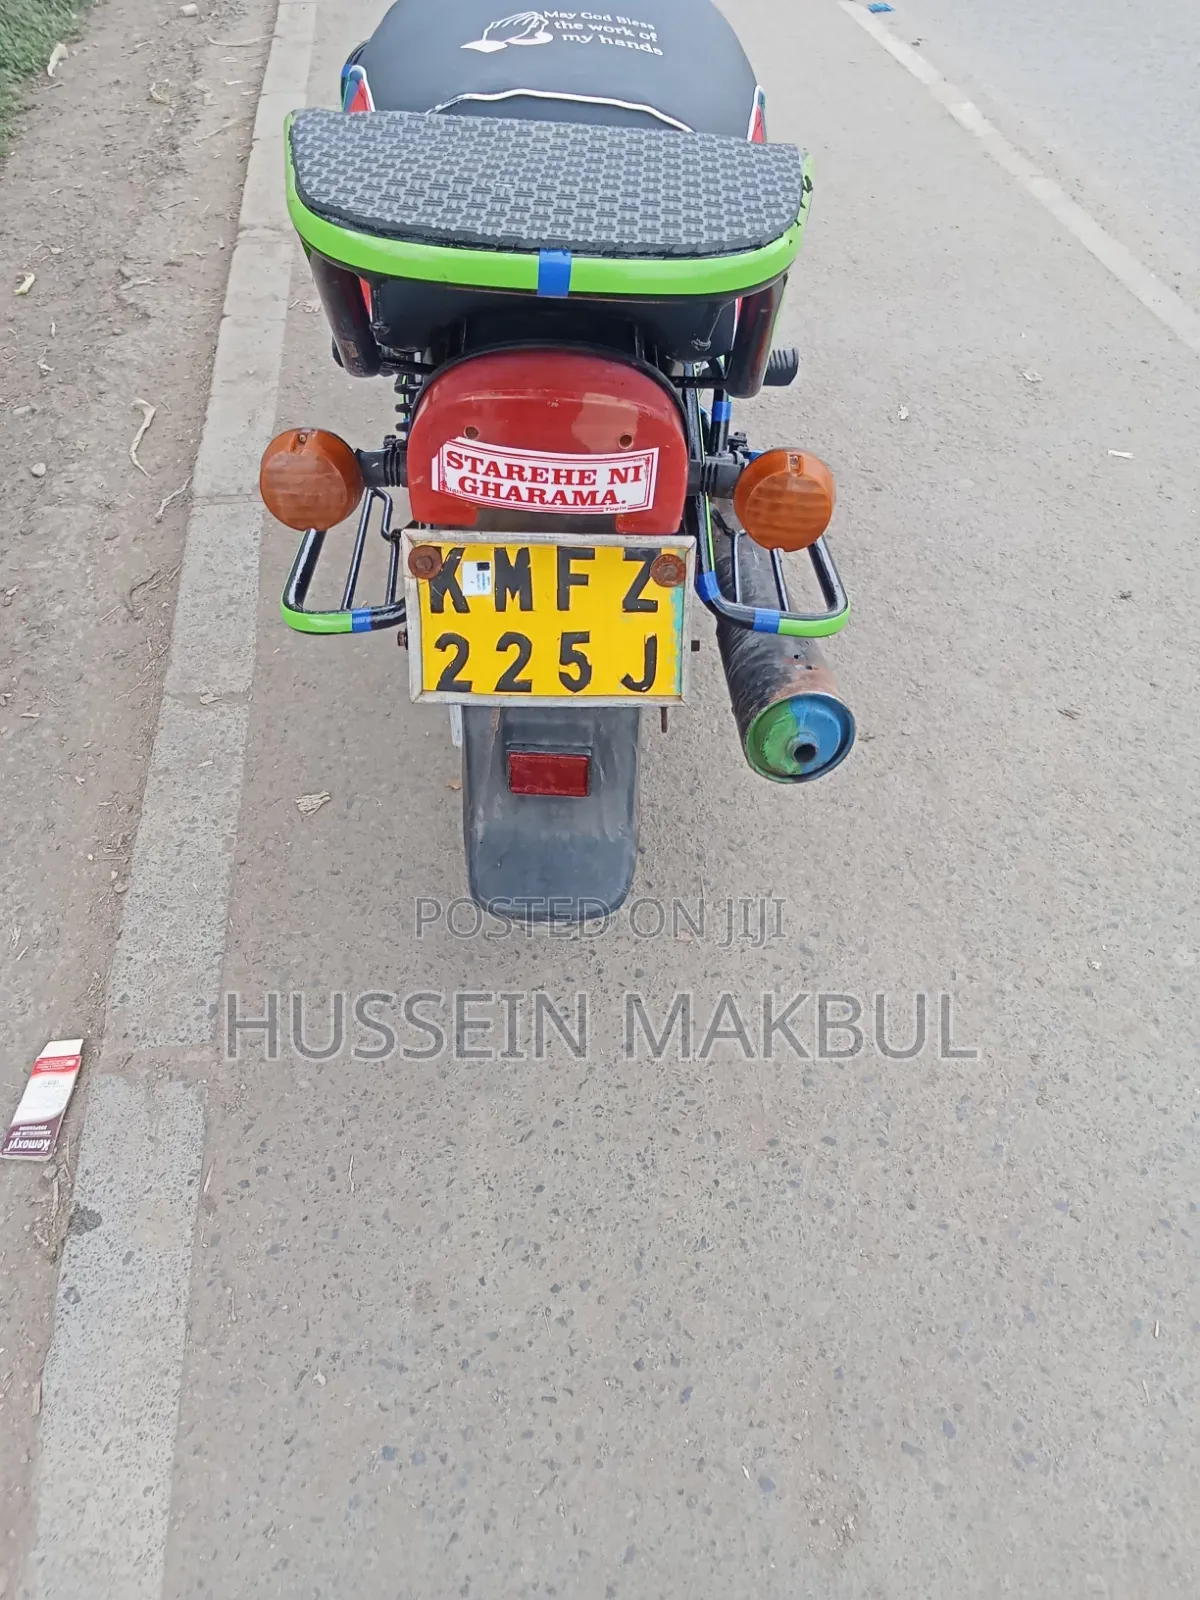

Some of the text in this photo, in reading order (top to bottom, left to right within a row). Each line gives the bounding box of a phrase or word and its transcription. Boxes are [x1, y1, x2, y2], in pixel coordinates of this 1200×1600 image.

[544, 11, 655, 30] May God Bless
[554, 21, 658, 42] the work of
[561, 33, 664, 56] my hands
[446, 451, 596, 486] STAREHE
[608, 465, 643, 485] NI
[458, 476, 627, 506] GHARAMA.
[434, 631, 658, 694] 225J
